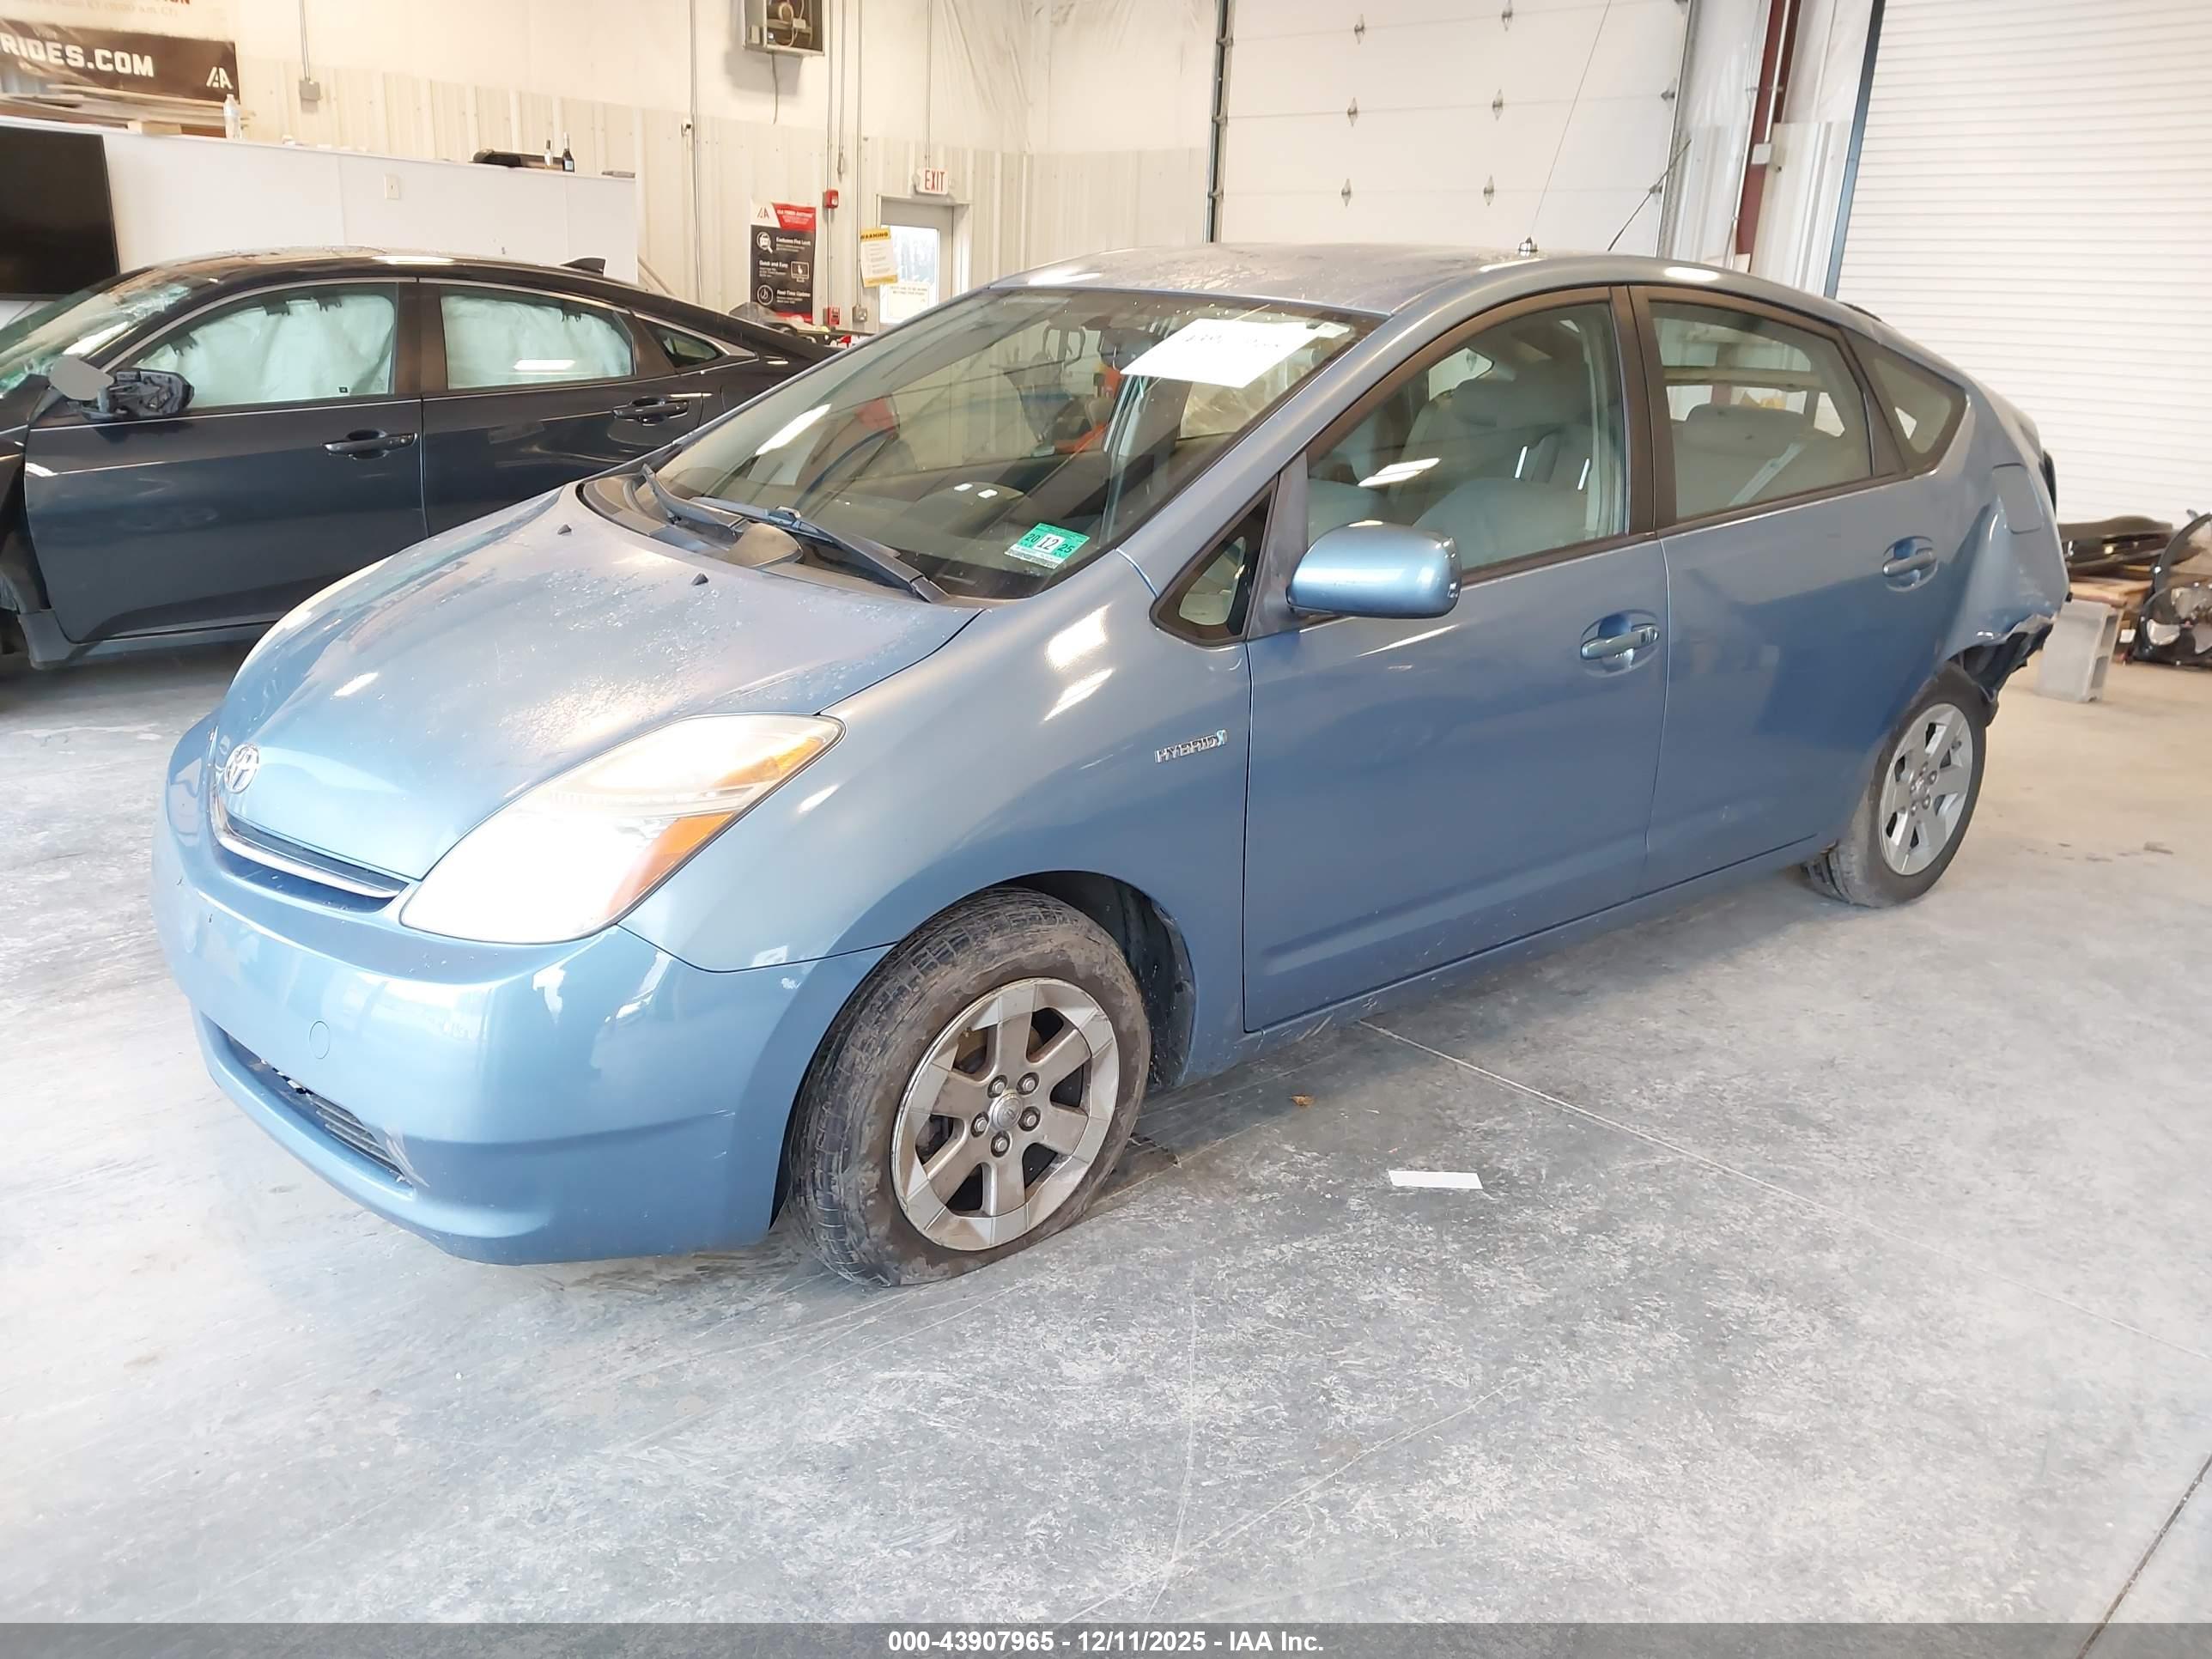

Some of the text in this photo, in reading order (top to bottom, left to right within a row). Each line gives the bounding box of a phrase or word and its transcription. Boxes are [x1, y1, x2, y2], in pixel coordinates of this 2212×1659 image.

[0, 33, 155, 78] RIDES.COM
[925, 170, 945, 191] EXIT
[1024, 533, 1041, 543] 20
[1037, 537, 1059, 550] 12
[1057, 544, 1075, 553] 25
[1154, 735, 1218, 763] HYBRID
